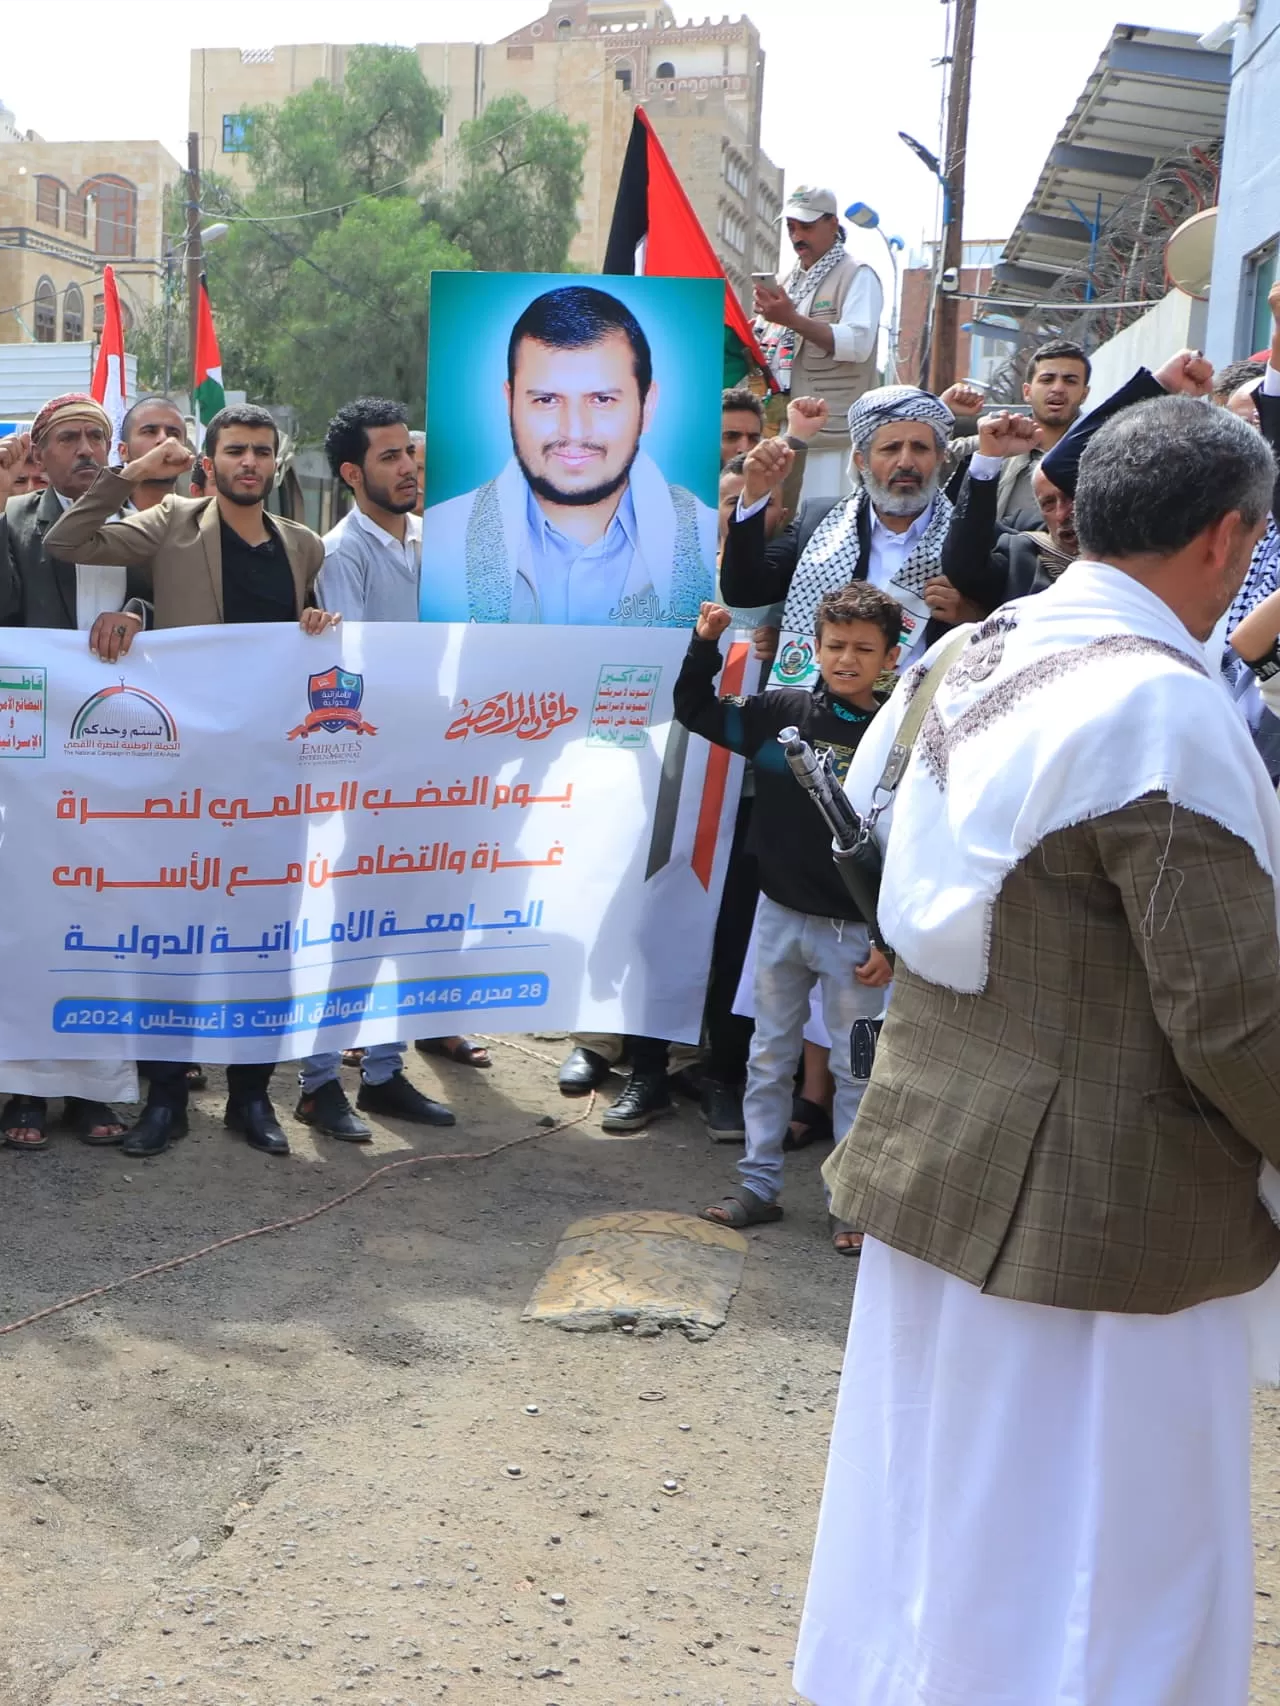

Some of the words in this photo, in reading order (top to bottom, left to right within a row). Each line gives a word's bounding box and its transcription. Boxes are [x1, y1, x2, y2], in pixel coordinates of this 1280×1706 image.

[608, 594, 660, 627] القائد
[81, 723, 128, 738] وحدكم
[121, 740, 153, 750] الوطنية
[130, 725, 162, 739] لستم
[301, 740, 363, 755] EMIRATES
[56, 788, 202, 824] لنصرة
[208, 780, 358, 827] العالمي
[362, 776, 489, 816] الغضب
[492, 783, 574, 809] يوم
[52, 851, 221, 892] الأسرى
[308, 842, 466, 889] والتضامن
[471, 840, 565, 873] غزة
[226, 862, 302, 896] مع
[378, 899, 544, 937] الجامعة
[64, 924, 205, 960] الدولية
[466, 985, 513, 1005] محرم
[519, 983, 542, 998] 28
[60, 1009, 133, 1028] 2024م
[140, 1005, 227, 1030] أغسطس
[231, 1012, 245, 1028] 3
[251, 1002, 304, 1032] السبت
[308, 992, 375, 1024] الموافق
